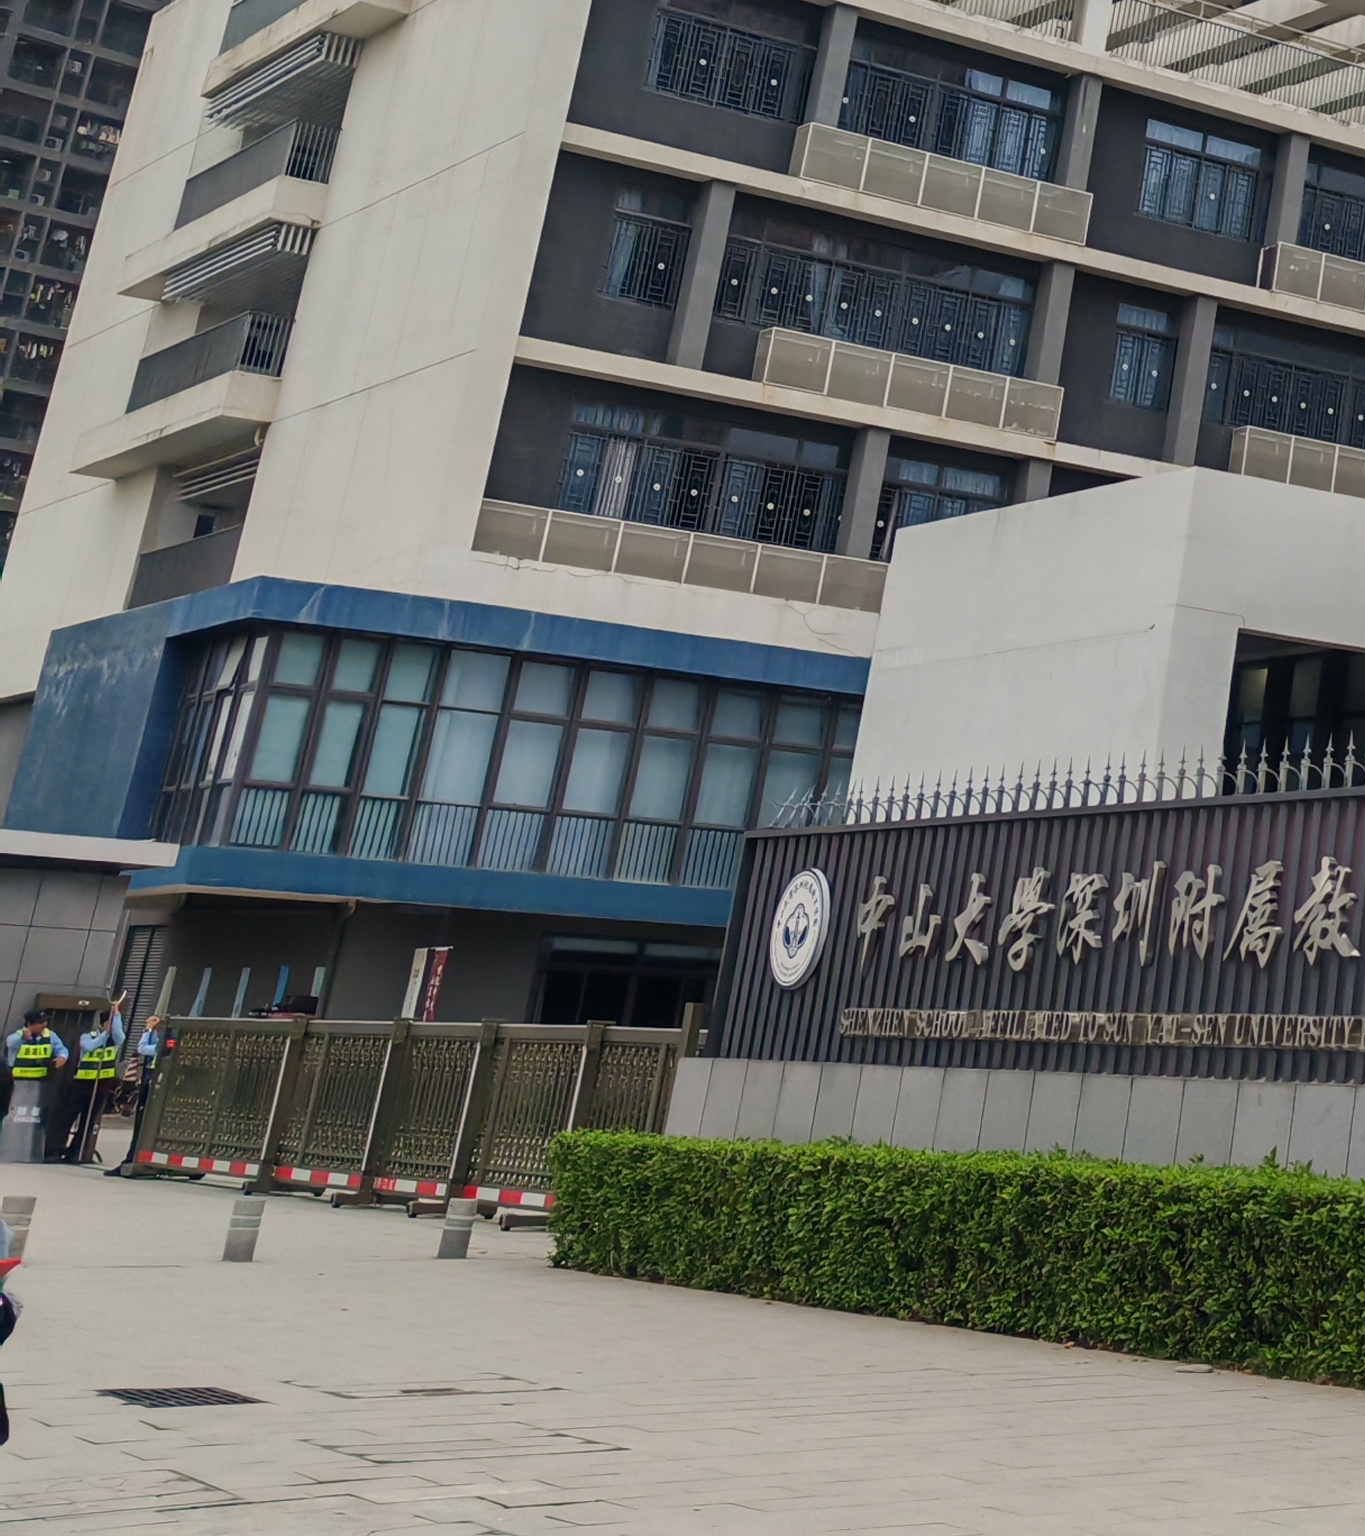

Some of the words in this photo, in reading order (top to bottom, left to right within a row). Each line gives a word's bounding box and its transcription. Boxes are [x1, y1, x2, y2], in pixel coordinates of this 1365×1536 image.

[840, 1008, 911, 1037] SHENZHEN
[915, 1009, 969, 1039] SCHOOL
[975, 1010, 1073, 1041] AFFILIATED
[1078, 1012, 1101, 1042] TO
[1102, 1013, 1133, 1043] SUN
[1146, 1014, 1228, 1046] YAT-SEN
[1233, 1015, 1356, 1049] UNIVERSITY
